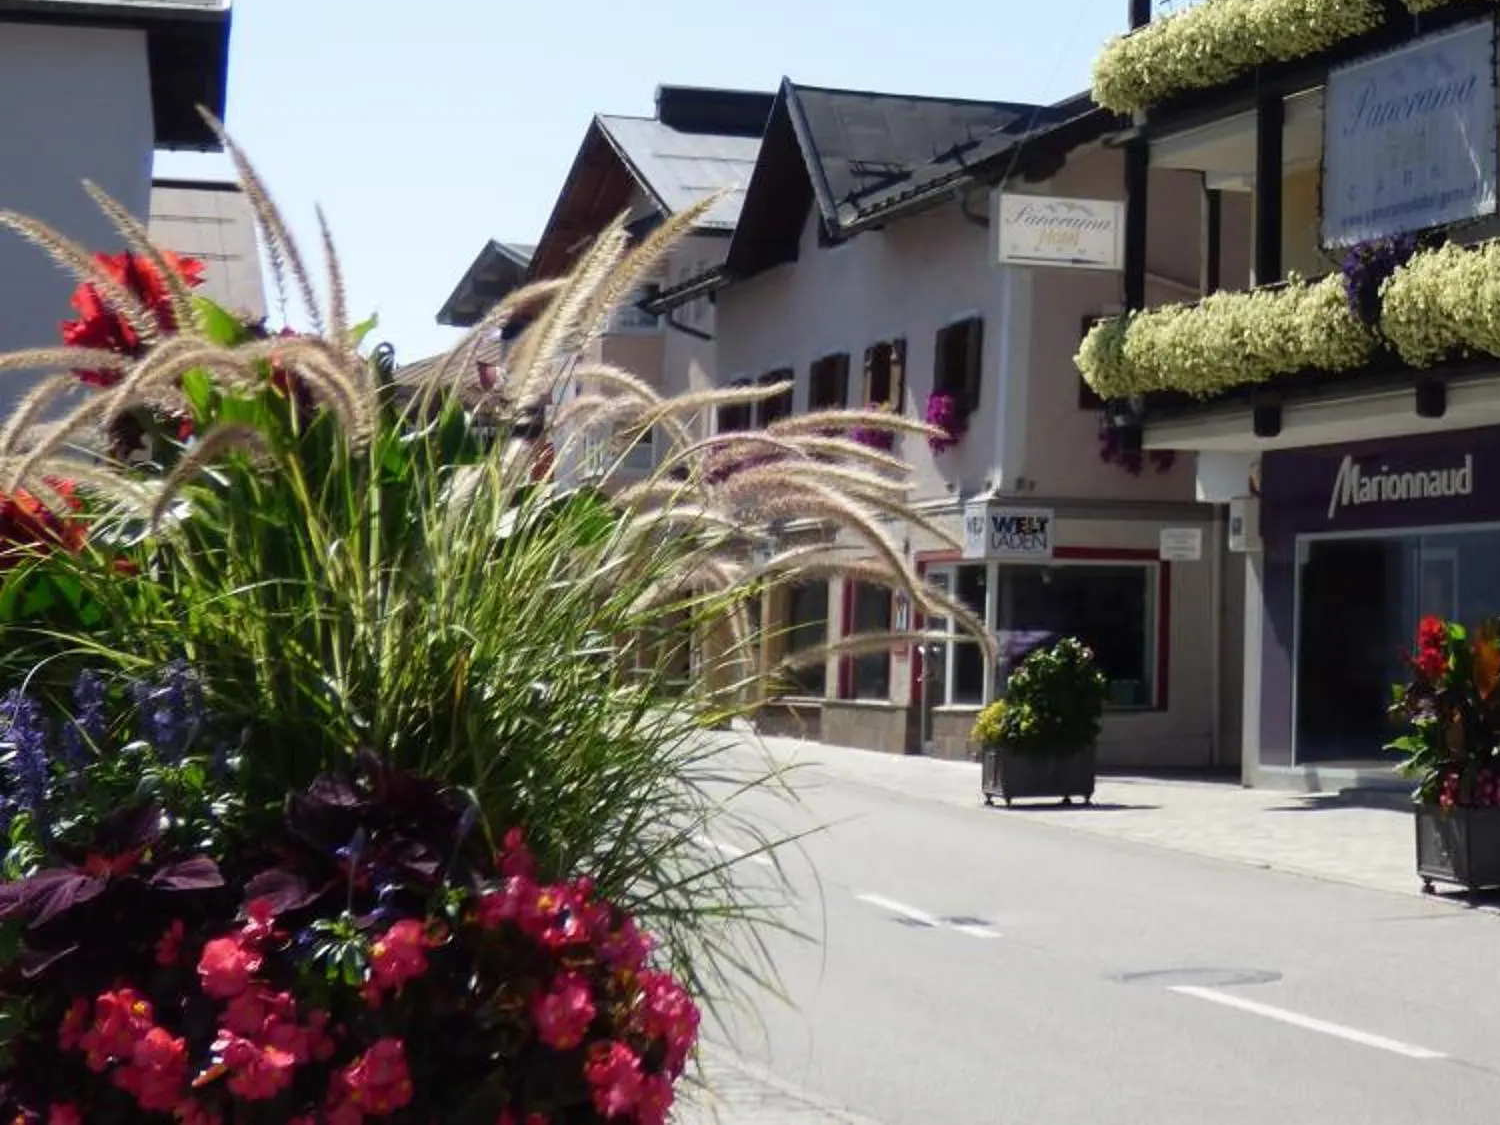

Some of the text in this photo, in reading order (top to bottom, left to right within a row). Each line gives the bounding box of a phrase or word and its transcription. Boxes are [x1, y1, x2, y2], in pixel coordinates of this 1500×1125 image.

[1328, 455, 1472, 519] Marionnaud
[991, 516, 1050, 533] WELT
[991, 532, 1048, 550] LADEN
